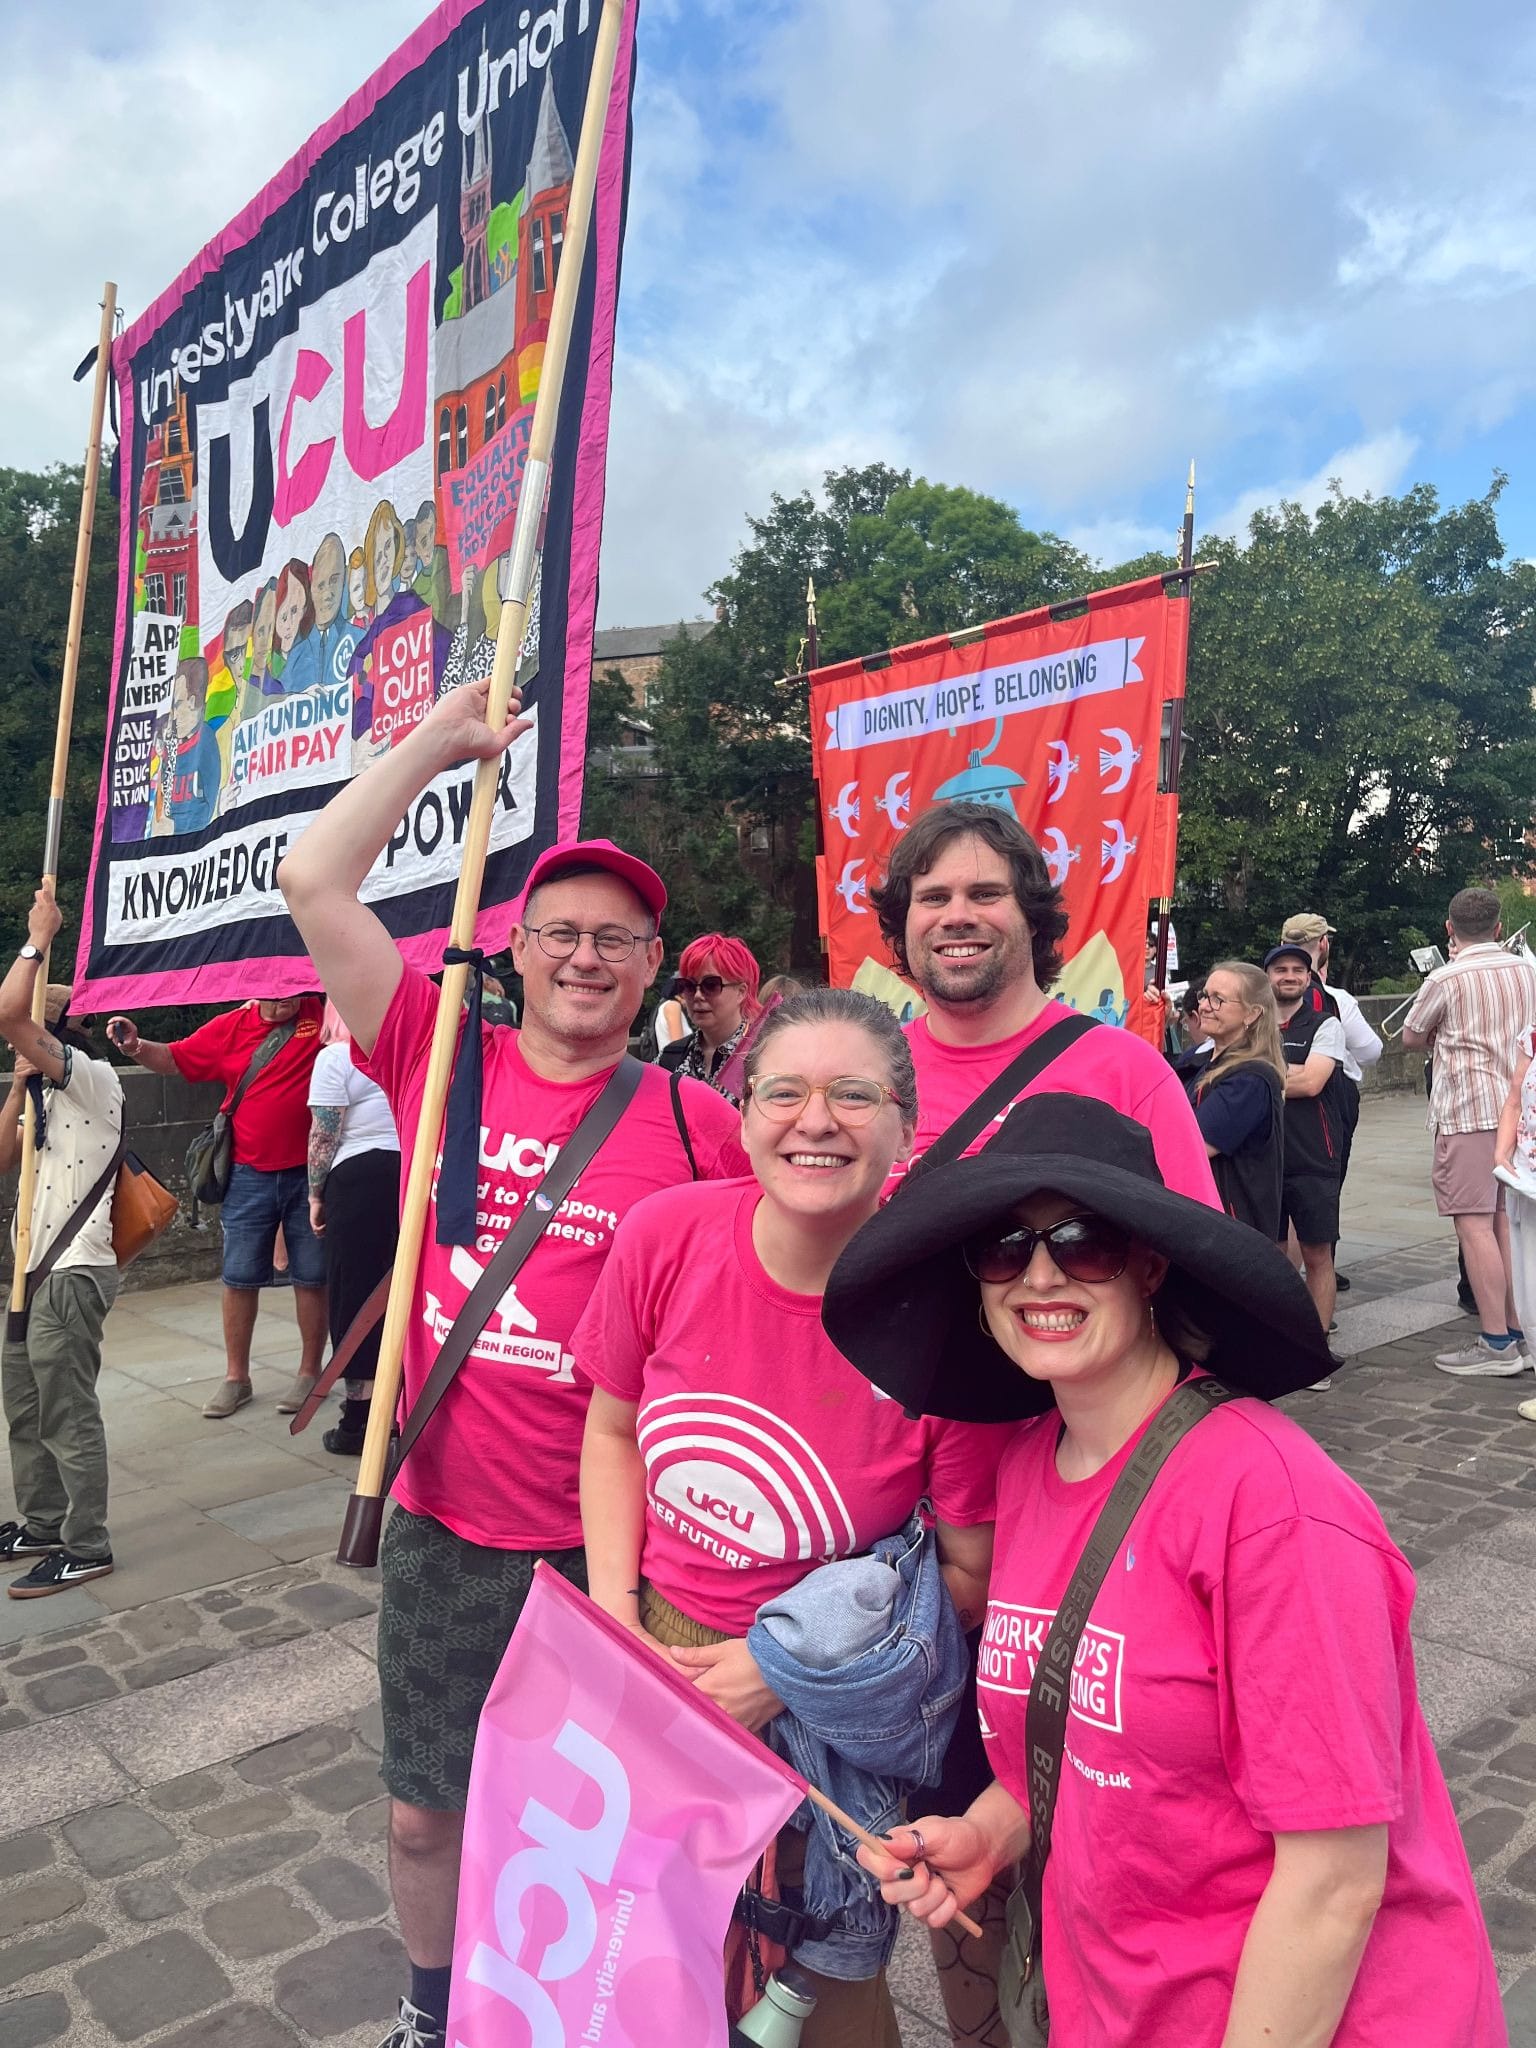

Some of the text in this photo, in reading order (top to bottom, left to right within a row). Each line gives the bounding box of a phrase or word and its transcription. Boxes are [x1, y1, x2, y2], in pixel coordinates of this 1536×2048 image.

[209, 259, 431, 584] UCU
[451, 415, 534, 506] EQUALIT
[130, 655, 166, 680] THE
[383, 661, 430, 708] OUR
[263, 684, 349, 740] FUNDING
[864, 653, 1097, 735] DIGNITY, HOPE, BELONGING
[118, 719, 152, 743] AVE
[291, 723, 346, 768] PAY
[112, 784, 149, 807] ATION
[121, 747, 518, 921] KNOWLEDGE POWR
[494, 1186, 520, 1206] to
[503, 1343, 556, 1362] REGION
[679, 1519, 752, 1570] FUTURE
[981, 1645, 1016, 1682] NOT
